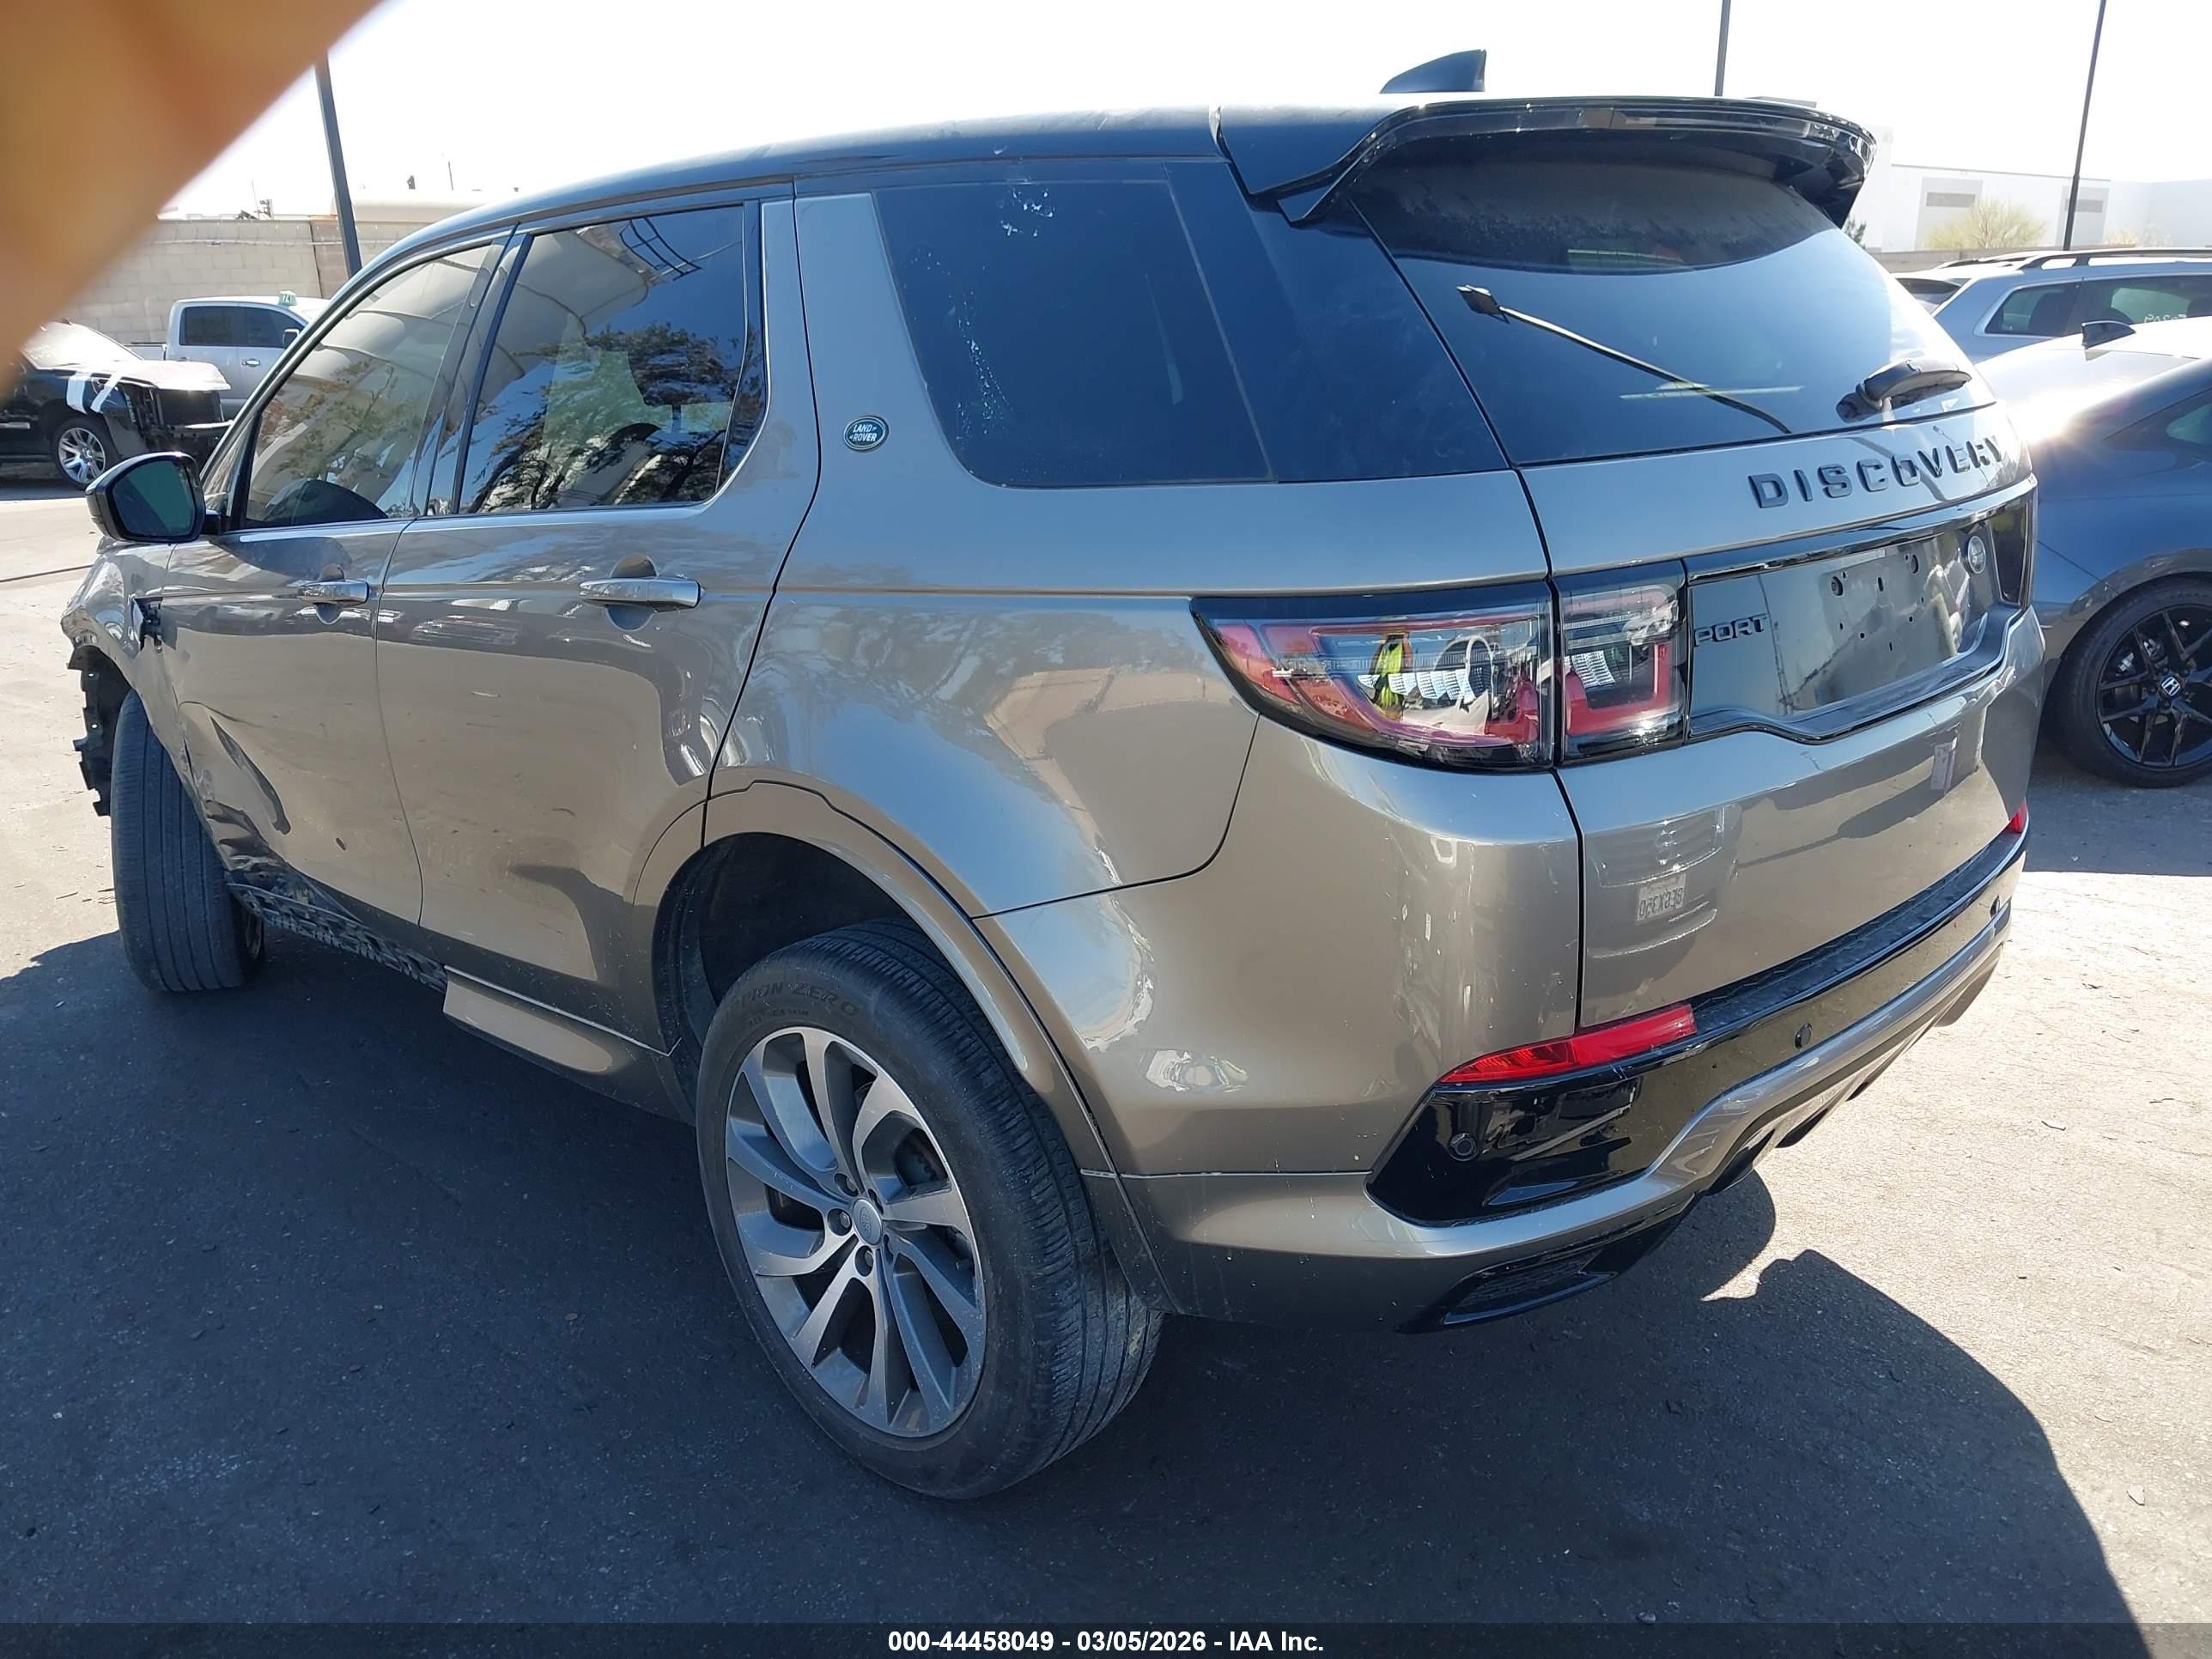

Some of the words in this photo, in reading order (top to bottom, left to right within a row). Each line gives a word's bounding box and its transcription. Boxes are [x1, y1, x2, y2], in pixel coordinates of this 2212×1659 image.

[853, 423, 873, 433] LAND
[853, 432, 878, 442] ROVER
[1747, 436, 2002, 509] DISCOVERY
